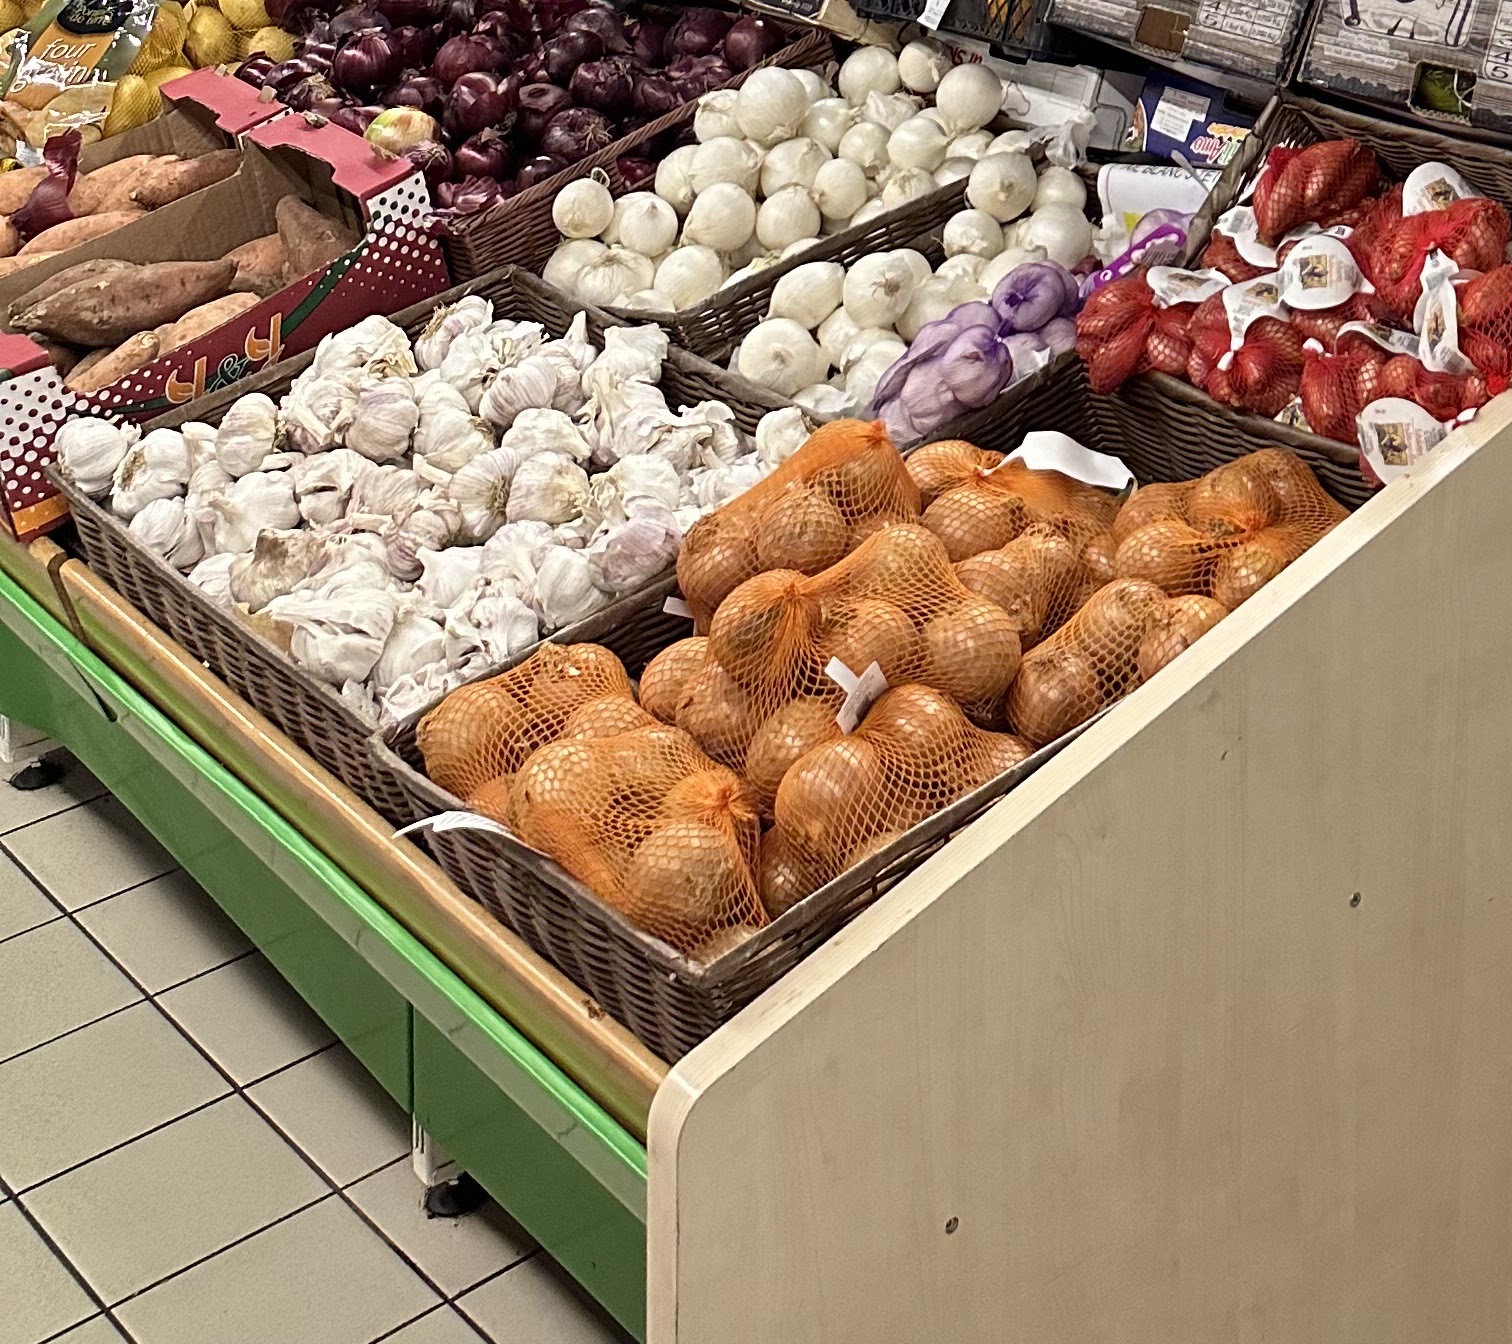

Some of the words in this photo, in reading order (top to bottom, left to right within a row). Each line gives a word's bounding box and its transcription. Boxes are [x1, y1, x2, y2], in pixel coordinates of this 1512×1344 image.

[40, 38, 97, 61] four
[1493, 50, 1511, 63] 4
[1490, 65, 1509, 80] 5
